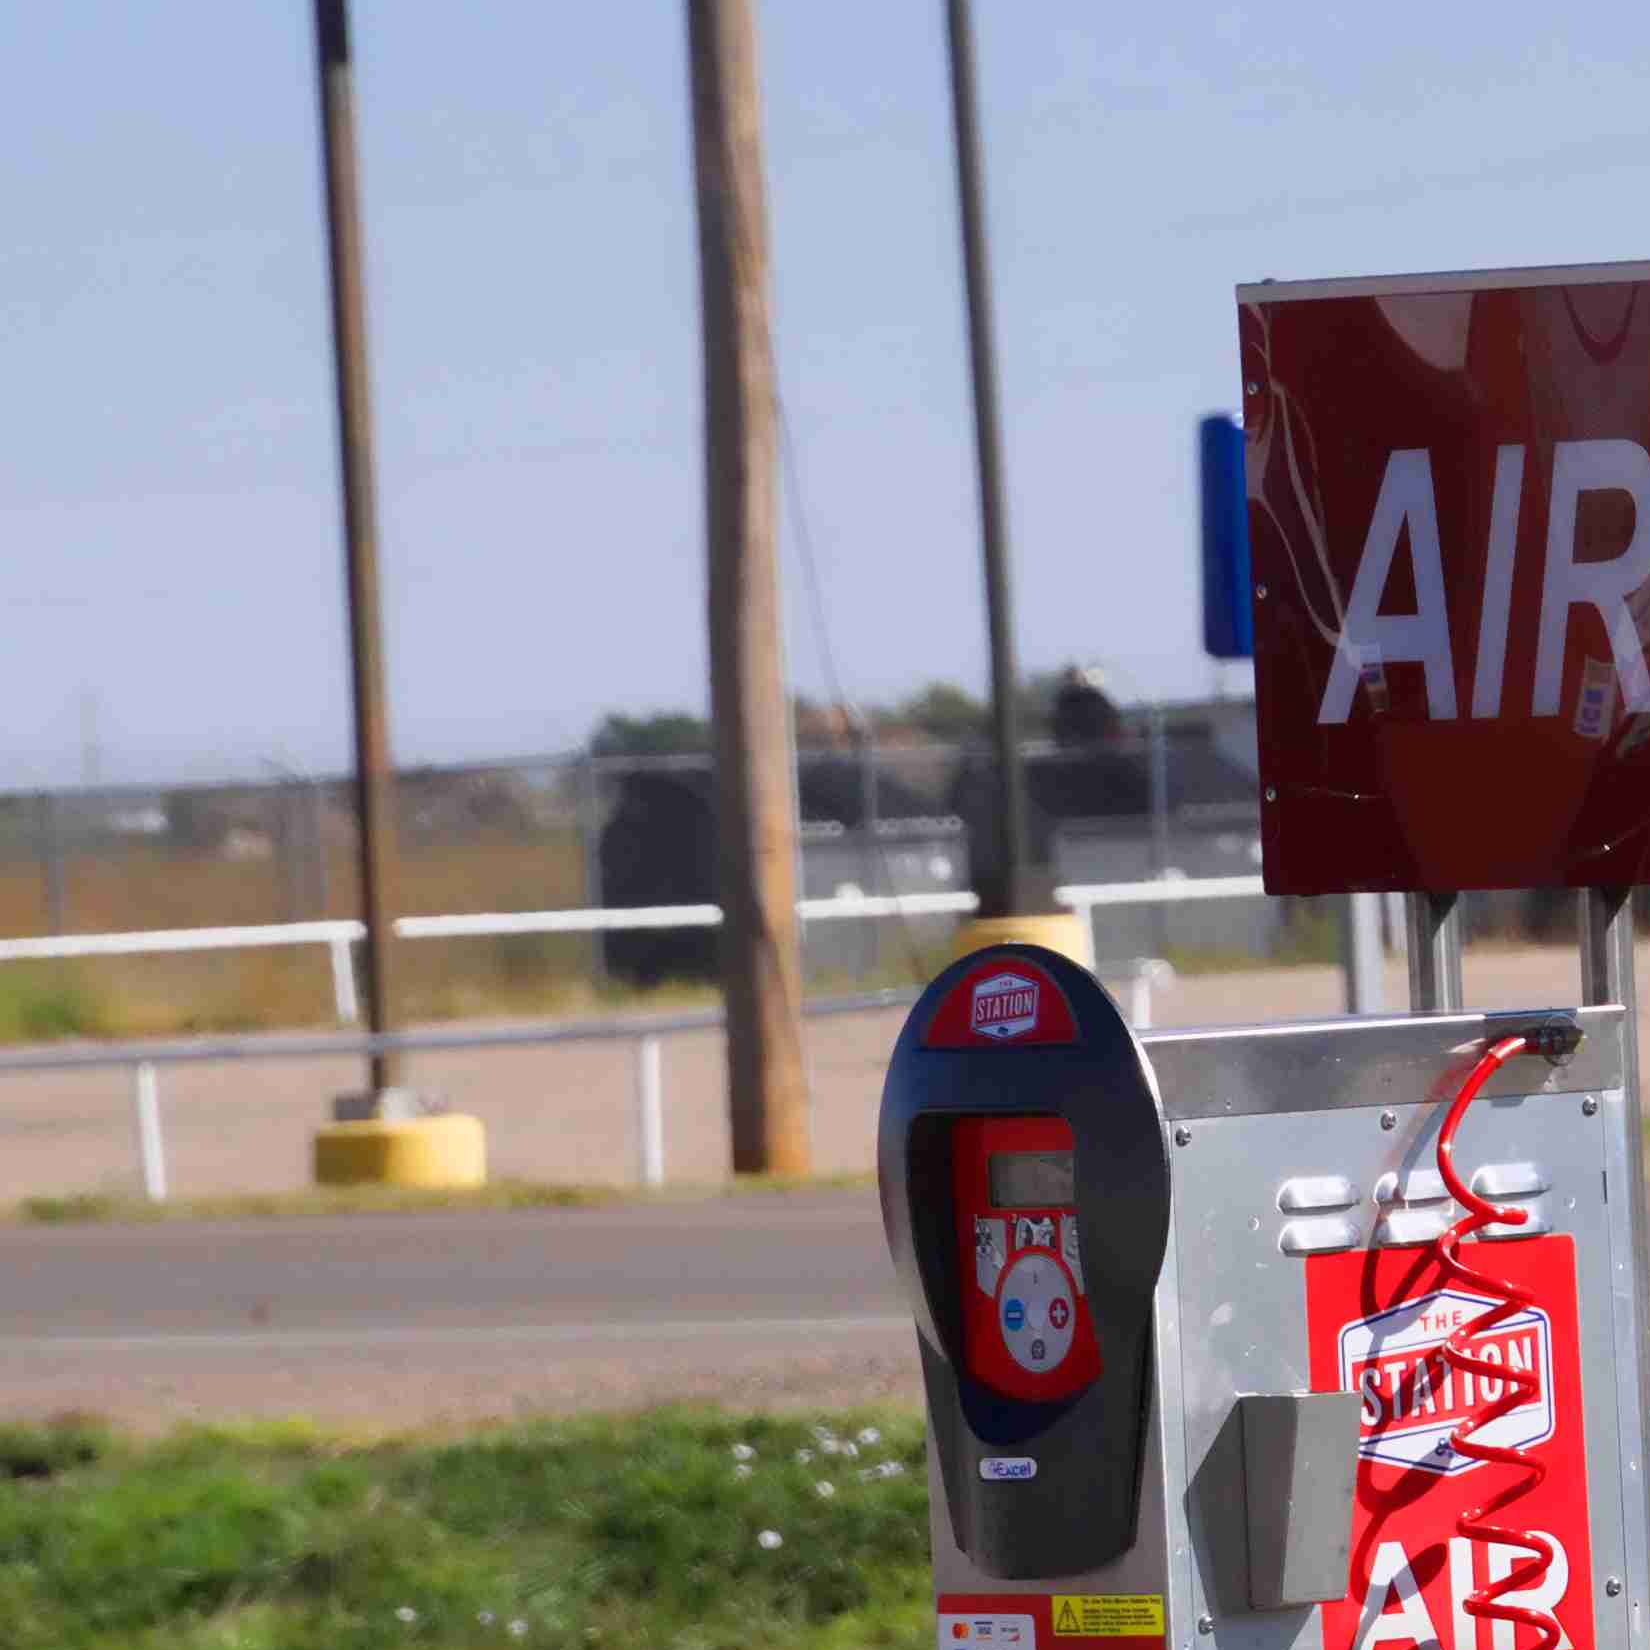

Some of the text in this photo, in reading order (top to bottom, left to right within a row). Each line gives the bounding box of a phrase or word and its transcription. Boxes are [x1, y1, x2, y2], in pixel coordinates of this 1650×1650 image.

[975, 990, 1034, 1022] STATION
[1421, 1310, 1464, 1333] THE
[1360, 1336, 1535, 1426] STATION
